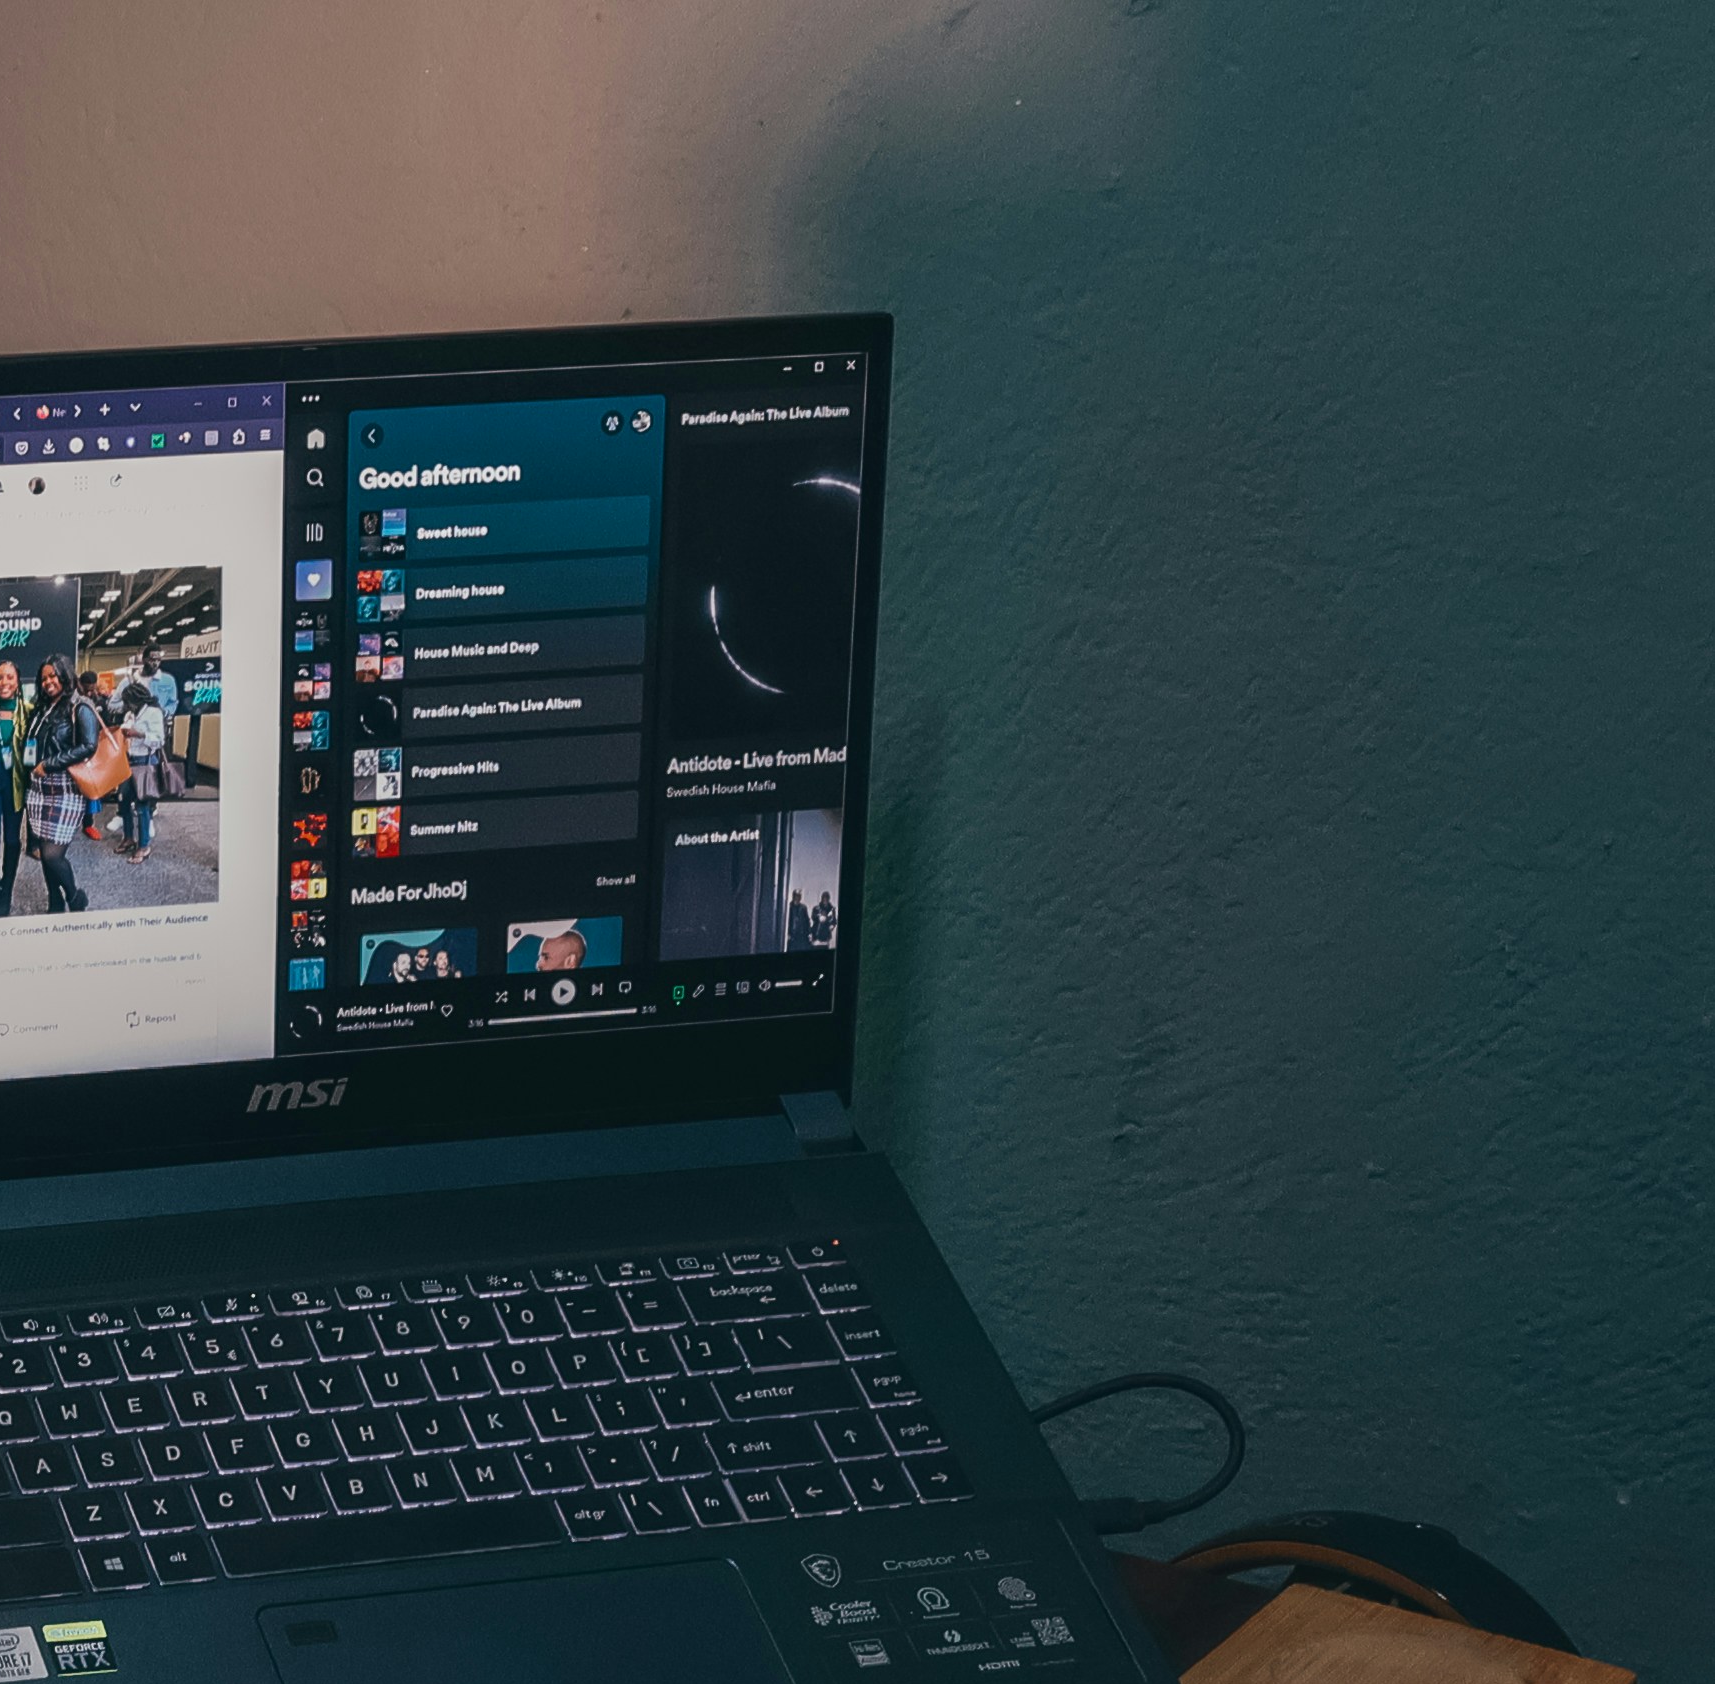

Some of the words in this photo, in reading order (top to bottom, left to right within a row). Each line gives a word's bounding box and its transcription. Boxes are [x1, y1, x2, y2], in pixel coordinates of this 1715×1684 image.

[681, 410, 729, 426] Paradise
[729, 408, 765, 425] Again:
[765, 408, 788, 421] The
[789, 406, 812, 420] Live
[812, 405, 850, 419] Album
[358, 464, 418, 490] Good
[420, 463, 521, 487] afternoon
[416, 526, 453, 540] Sweet
[453, 525, 488, 538] house
[415, 584, 470, 600] Dreaming
[471, 584, 505, 597] house
[414, 647, 450, 660] House
[451, 643, 485, 658] Music
[486, 641, 509, 655] and
[509, 641, 540, 655] Deep
[412, 704, 460, 719] Paradise
[460, 701, 497, 718] Again:
[497, 701, 520, 714] The
[520, 698, 545, 712] Live
[544, 697, 582, 711] Album
[666, 755, 733, 775] Antidote
[743, 751, 774, 769] Live
[775, 749, 811, 767] from
[813, 745, 848, 764] Mad
[411, 762, 476, 780] Progressive
[476, 760, 500, 774] Hits
[666, 784, 710, 798] Swedish
[711, 783, 745, 795] House
[746, 779, 777, 792] Mafia
[410, 823, 456, 836] Summer
[457, 820, 479, 833] hitz
[674, 832, 709, 847] About
[710, 831, 729, 844] the
[729, 828, 760, 843] Artist
[351, 885, 395, 905] Made
[397, 884, 423, 902] For
[422, 879, 468, 901] JhoDj
[145, 1013, 177, 1026] Repost
[246, 1076, 349, 1113] msi
[710, 1284, 773, 1297] backspace
[754, 1384, 795, 1398] enter
[883, 1555, 956, 1570] Creator
[54, 1641, 106, 1654] GEFORCE
[18, 1652, 32, 1667] i7
[57, 1650, 111, 1670] RTX
